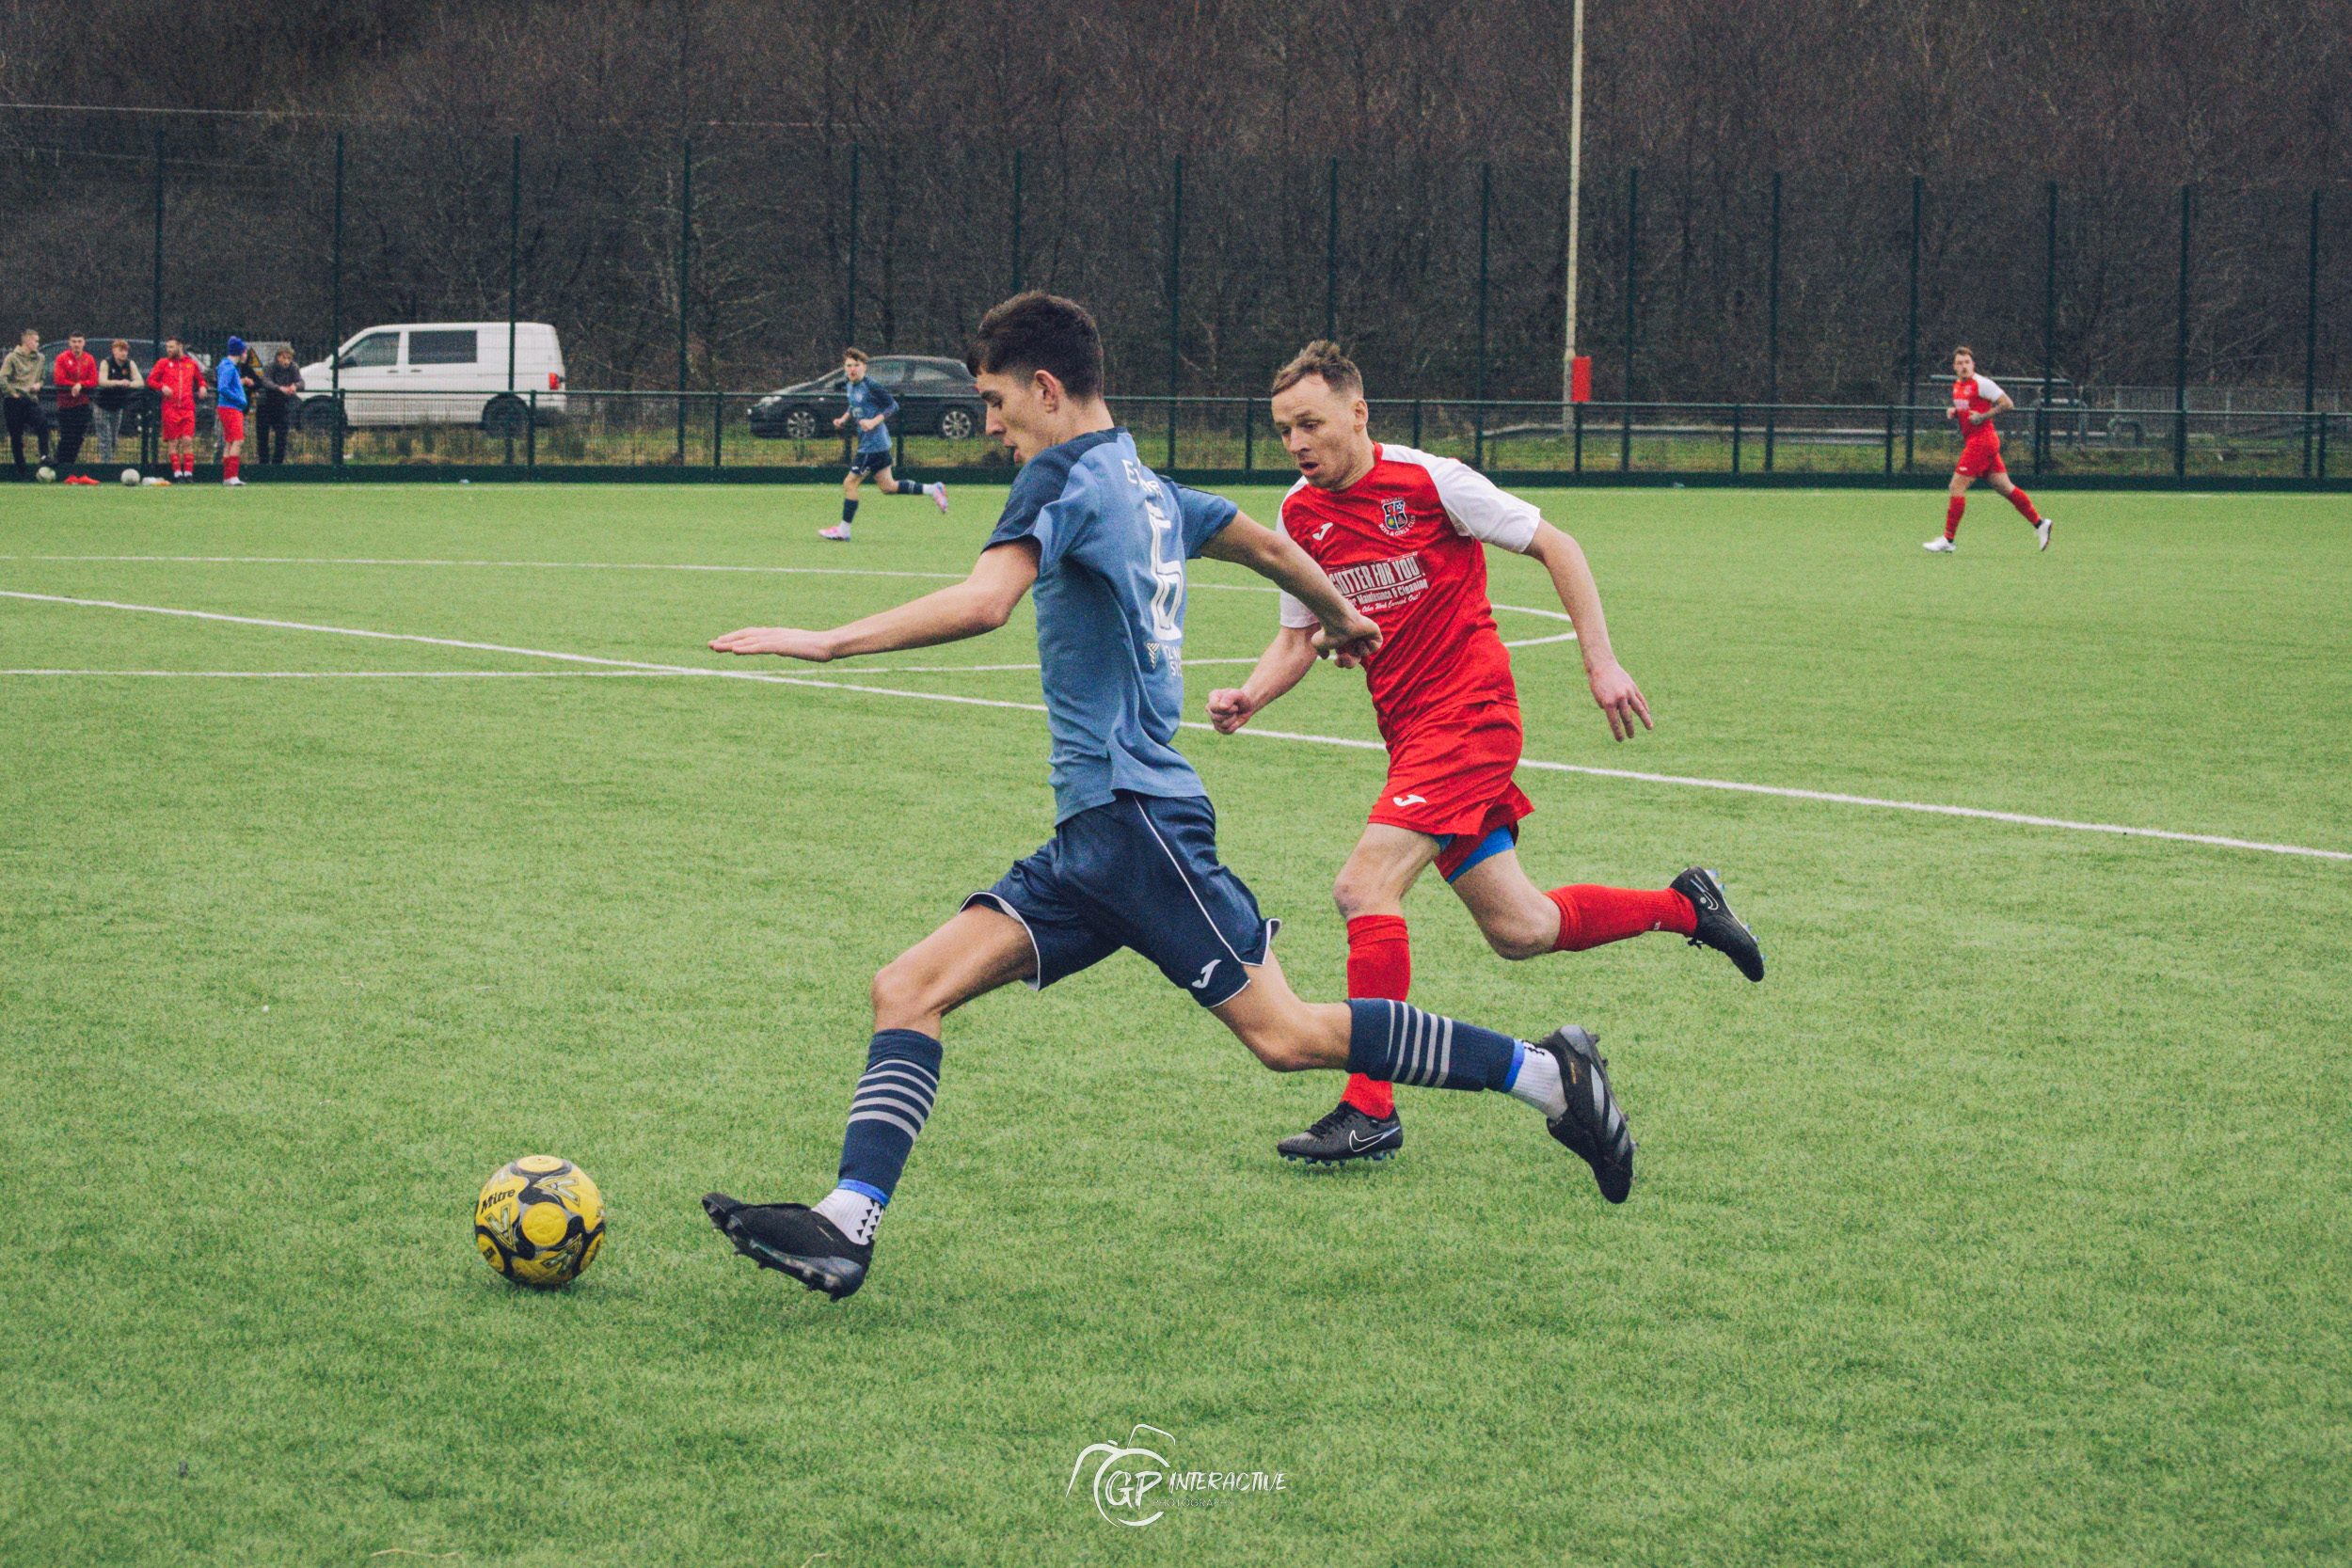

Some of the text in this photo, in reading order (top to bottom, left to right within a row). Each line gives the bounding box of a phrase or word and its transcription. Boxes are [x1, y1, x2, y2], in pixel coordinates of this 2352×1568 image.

[1144, 499, 1184, 641] 6
[1371, 562, 1395, 587] FOR
[1391, 556, 1421, 581] YOU
[1397, 578, 1428, 596] Cleaning
[481, 1189, 516, 1214] Mitre
